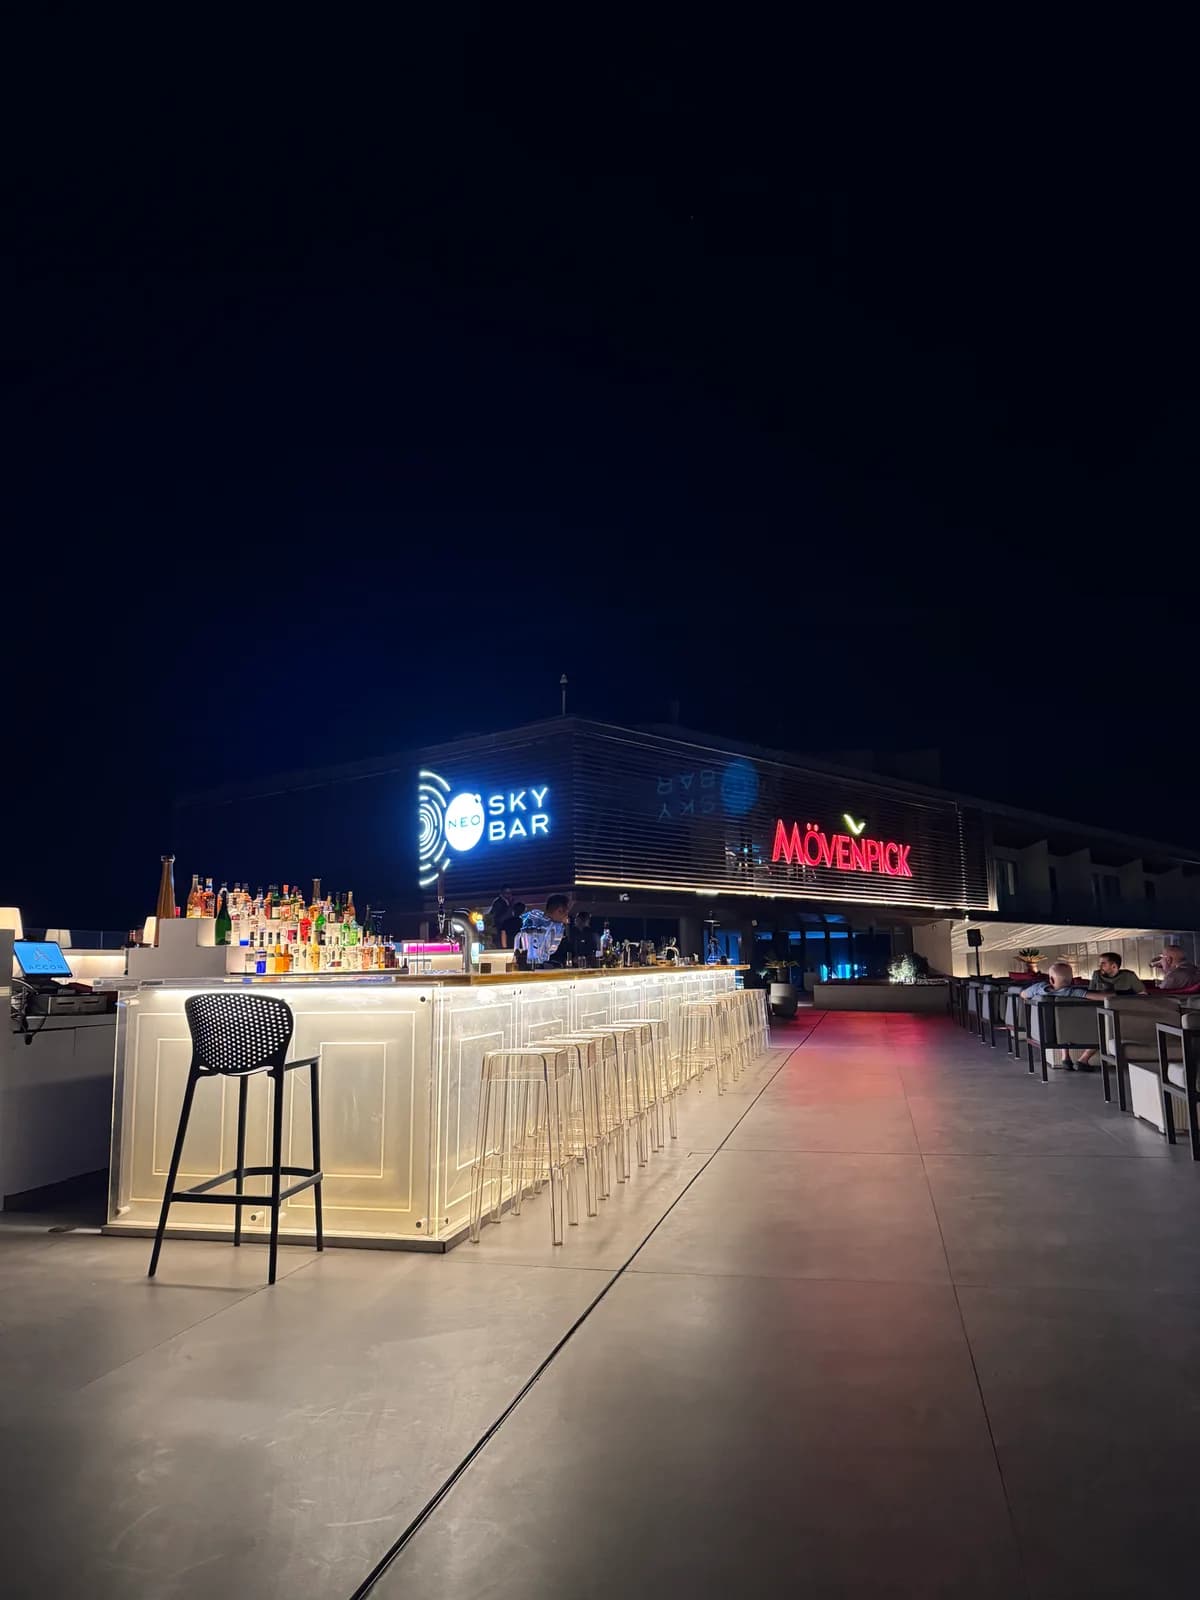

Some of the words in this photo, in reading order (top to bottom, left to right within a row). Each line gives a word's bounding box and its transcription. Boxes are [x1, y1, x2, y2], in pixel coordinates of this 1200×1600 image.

[488, 787, 548, 815] SKY
[448, 814, 481, 829] NEO
[489, 814, 549, 841] BAR
[771, 818, 912, 877] MÖVENPICK
